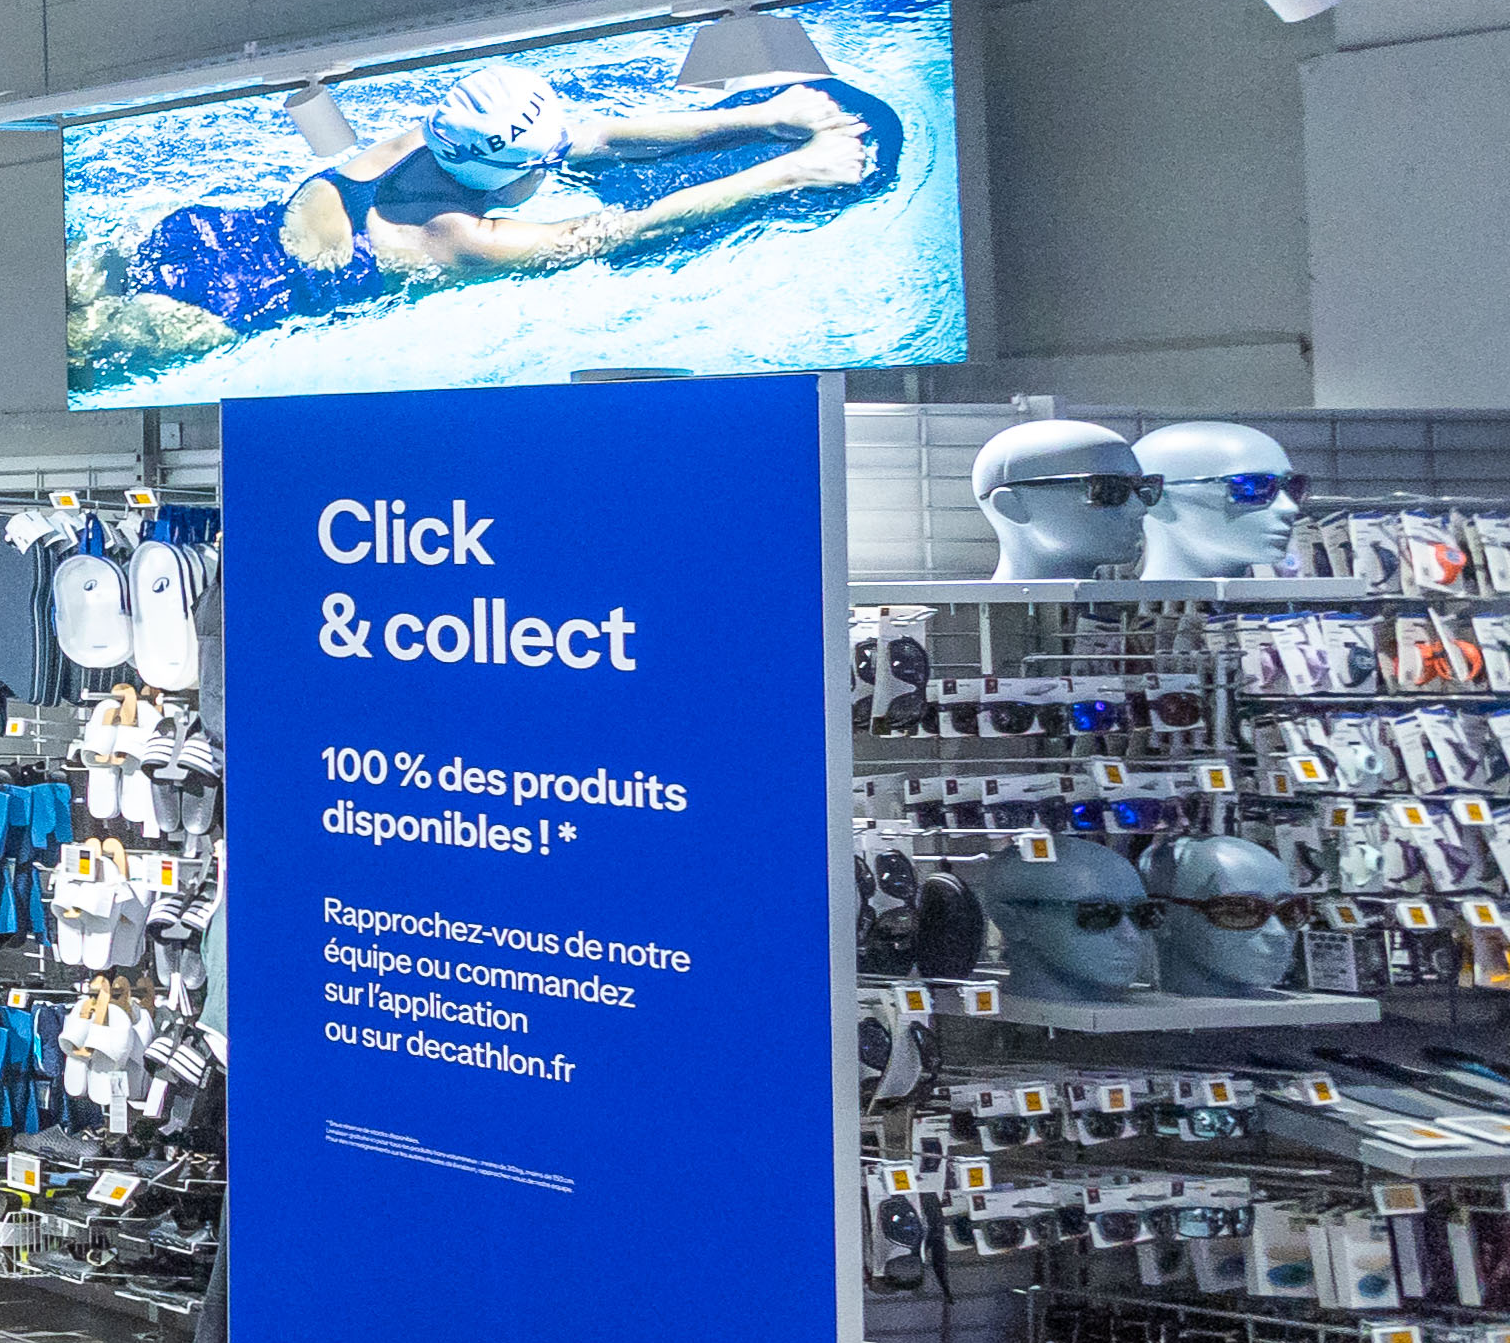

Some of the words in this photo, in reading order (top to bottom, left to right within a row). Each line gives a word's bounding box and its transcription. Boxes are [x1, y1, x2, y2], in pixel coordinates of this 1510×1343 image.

[442, 91, 545, 162] NABAIJI
[318, 499, 494, 565] Click
[319, 593, 372, 658] &
[384, 598, 636, 671] collect
[322, 747, 387, 784] 100
[394, 752, 432, 788] %
[438, 757, 507, 795] des
[514, 768, 687, 811] produits
[322, 796, 532, 853] disponibles
[540, 820, 549, 855] !
[324, 897, 559, 962] Rapprochez-vous
[565, 931, 603, 960] de
[609, 937, 691, 972] notre
[324, 938, 412, 976] équipe
[417, 958, 450, 980] ou
[456, 961, 635, 1008] commandez
[325, 983, 364, 1005] sur
[369, 980, 528, 1033] l’application
[325, 1022, 357, 1044] ou
[362, 1028, 402, 1051] sur
[407, 1031, 575, 1082] decathlon.fr
